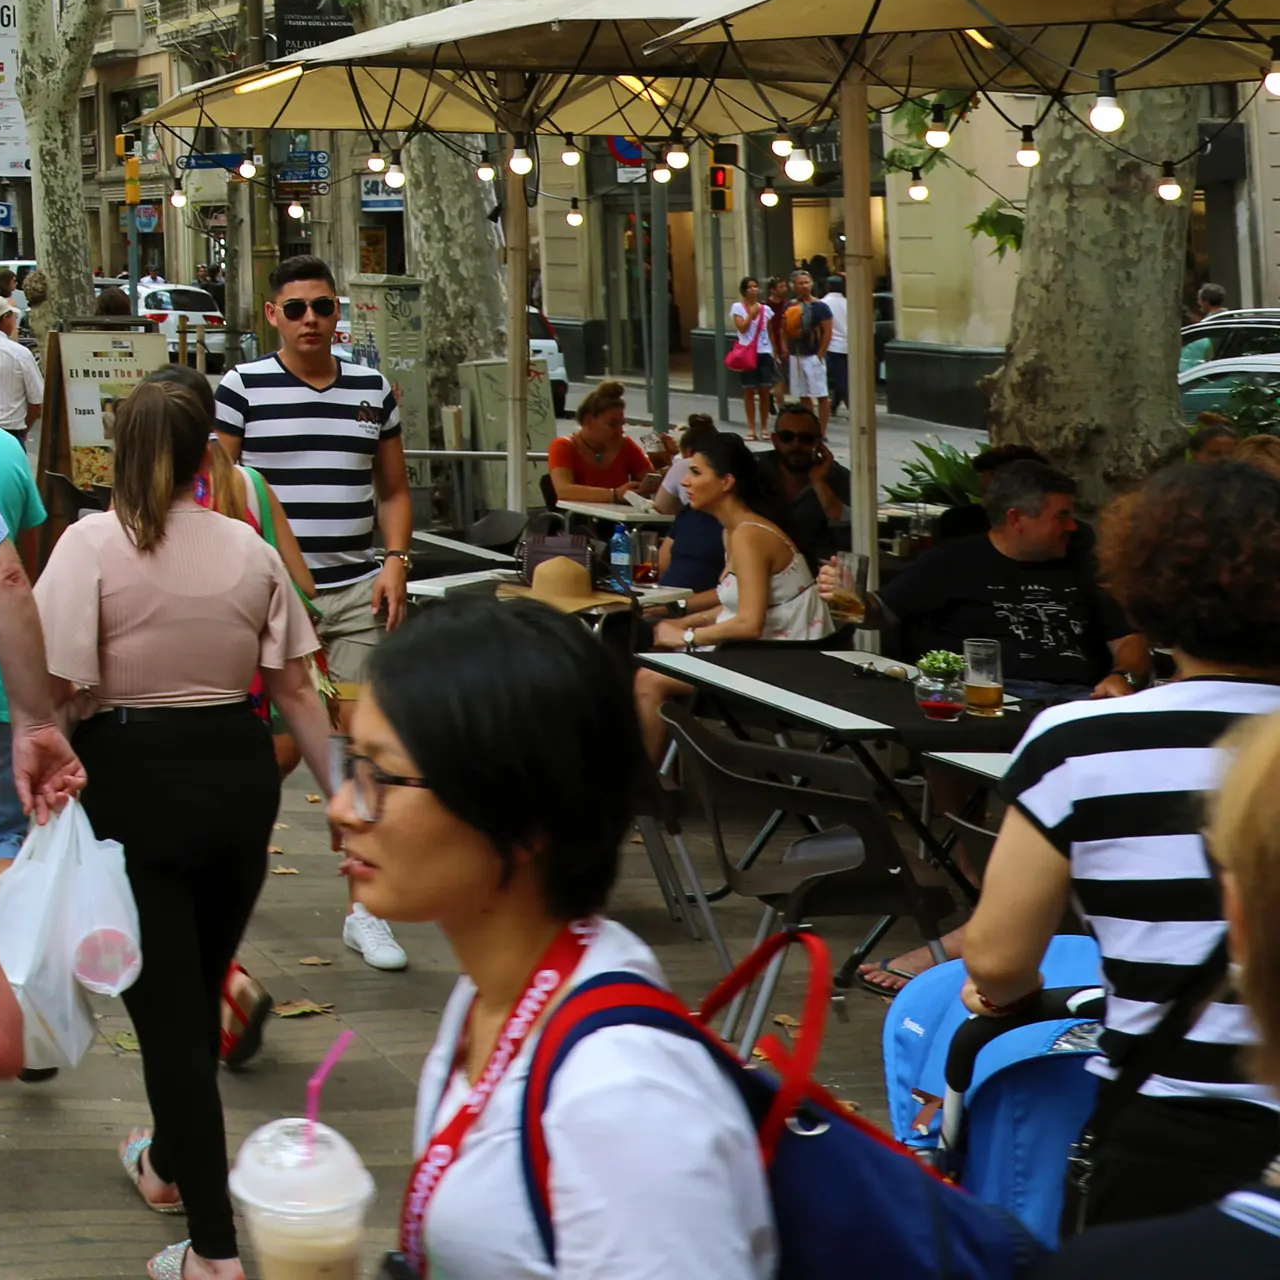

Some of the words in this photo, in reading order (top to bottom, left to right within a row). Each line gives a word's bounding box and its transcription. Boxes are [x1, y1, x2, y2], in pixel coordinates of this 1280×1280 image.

[69, 369, 78, 378] El
[83, 369, 110, 378] Menu
[114, 369, 132, 378] The
[74, 408, 95, 416] Tapas
